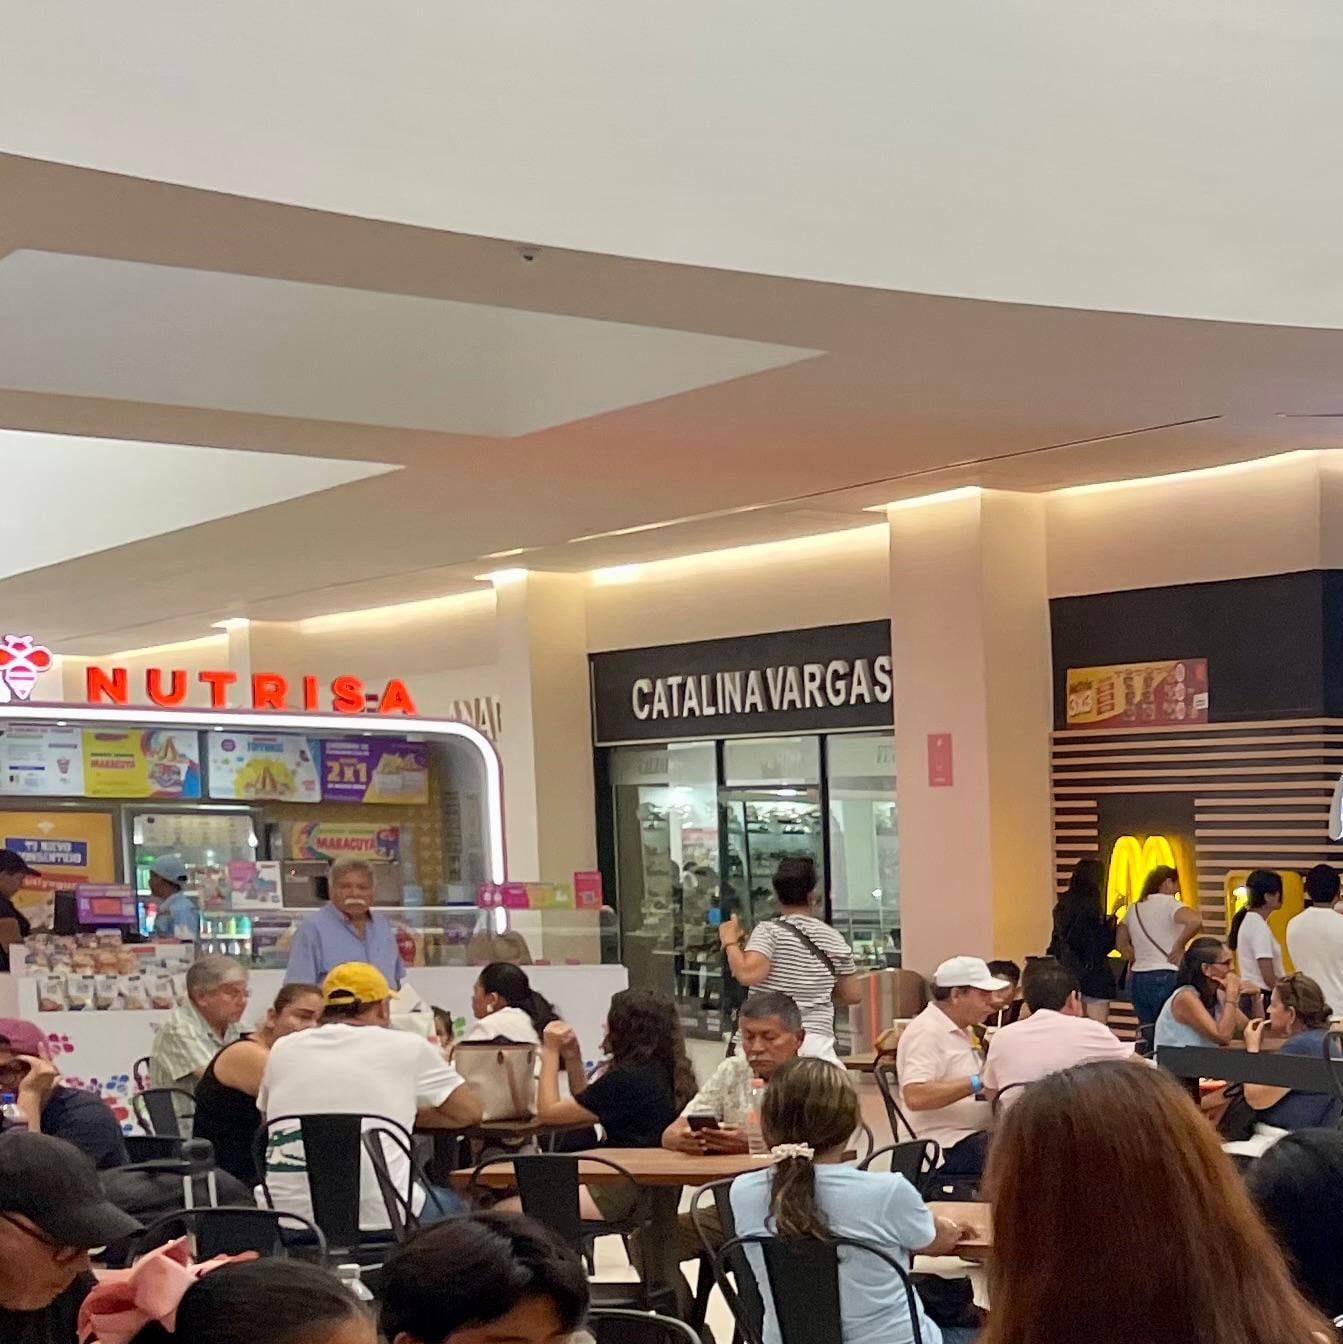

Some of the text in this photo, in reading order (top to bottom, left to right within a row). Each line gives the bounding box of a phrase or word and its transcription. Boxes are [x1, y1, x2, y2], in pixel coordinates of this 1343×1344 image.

[86, 665, 417, 716] NUTRISA
[631, 655, 892, 721] CATALINA VARGAS
